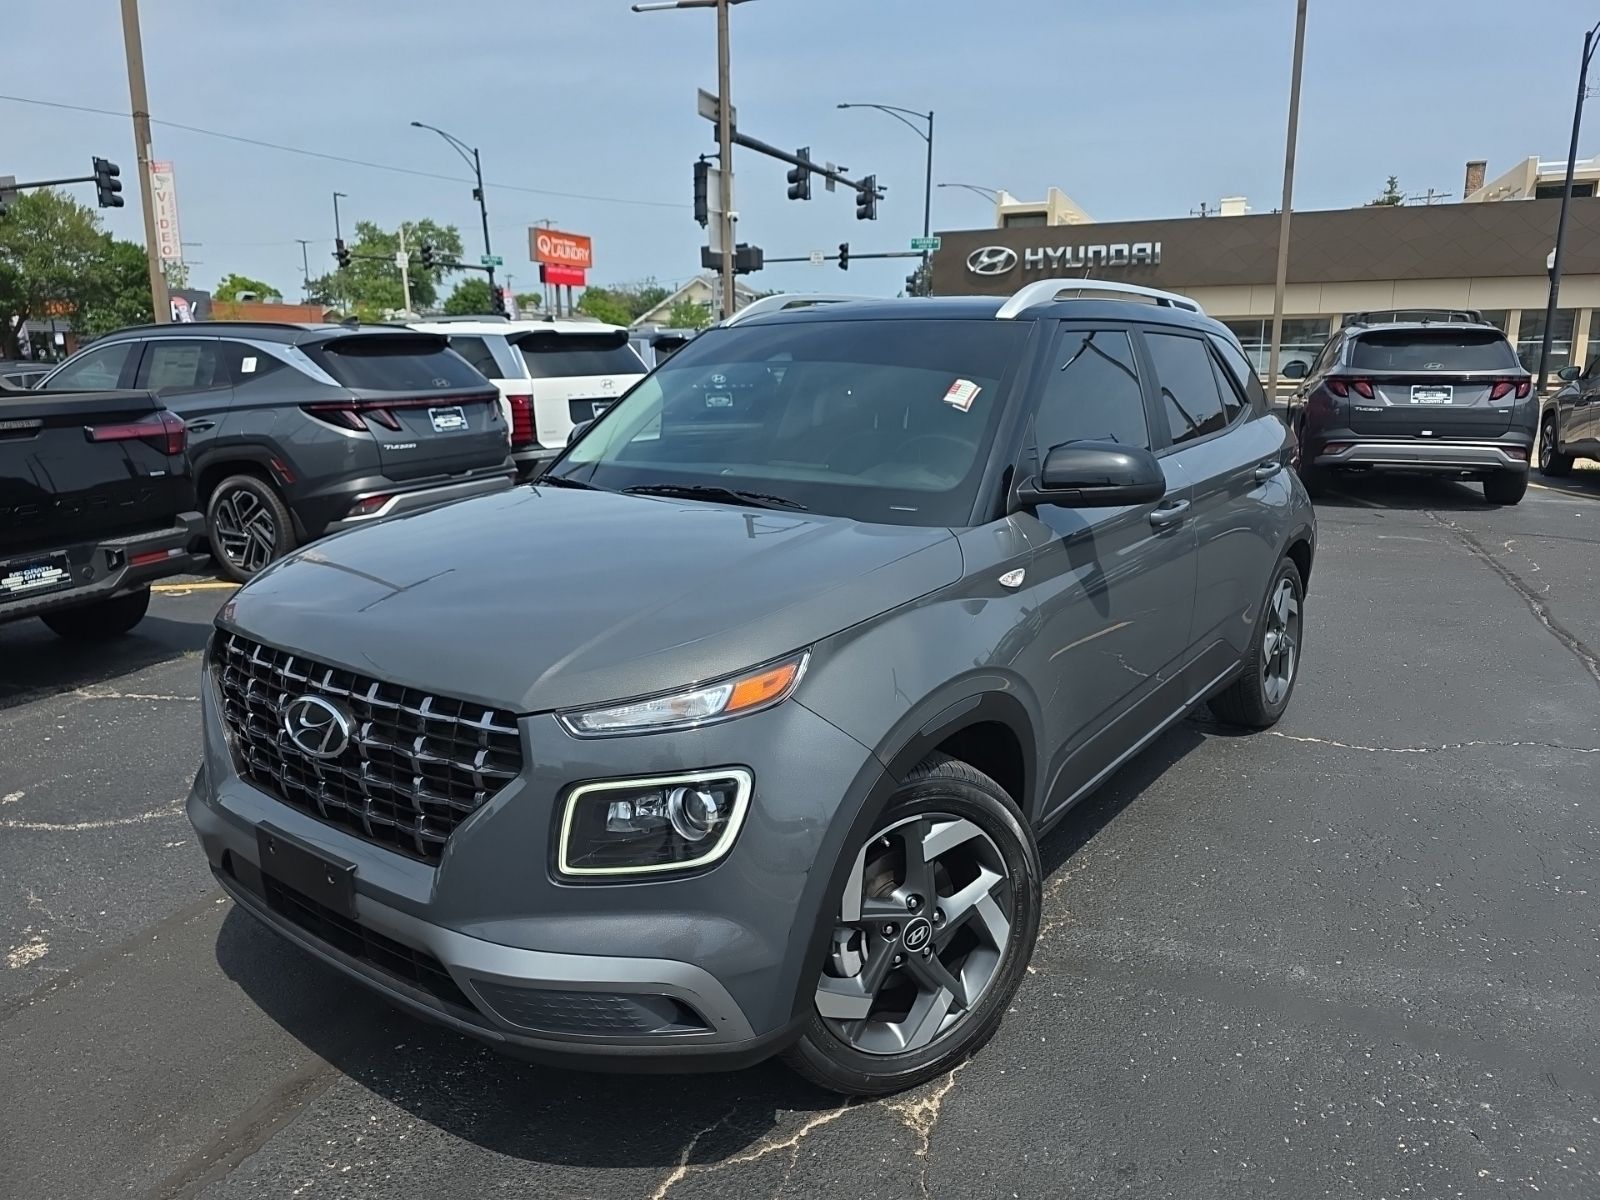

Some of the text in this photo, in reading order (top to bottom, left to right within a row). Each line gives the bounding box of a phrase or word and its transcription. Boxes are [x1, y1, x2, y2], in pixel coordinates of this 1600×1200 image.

[157, 191, 173, 255] VIDEO
[551, 243, 590, 261] LAUNDRY
[1025, 242, 1161, 270] HYUNDAI
